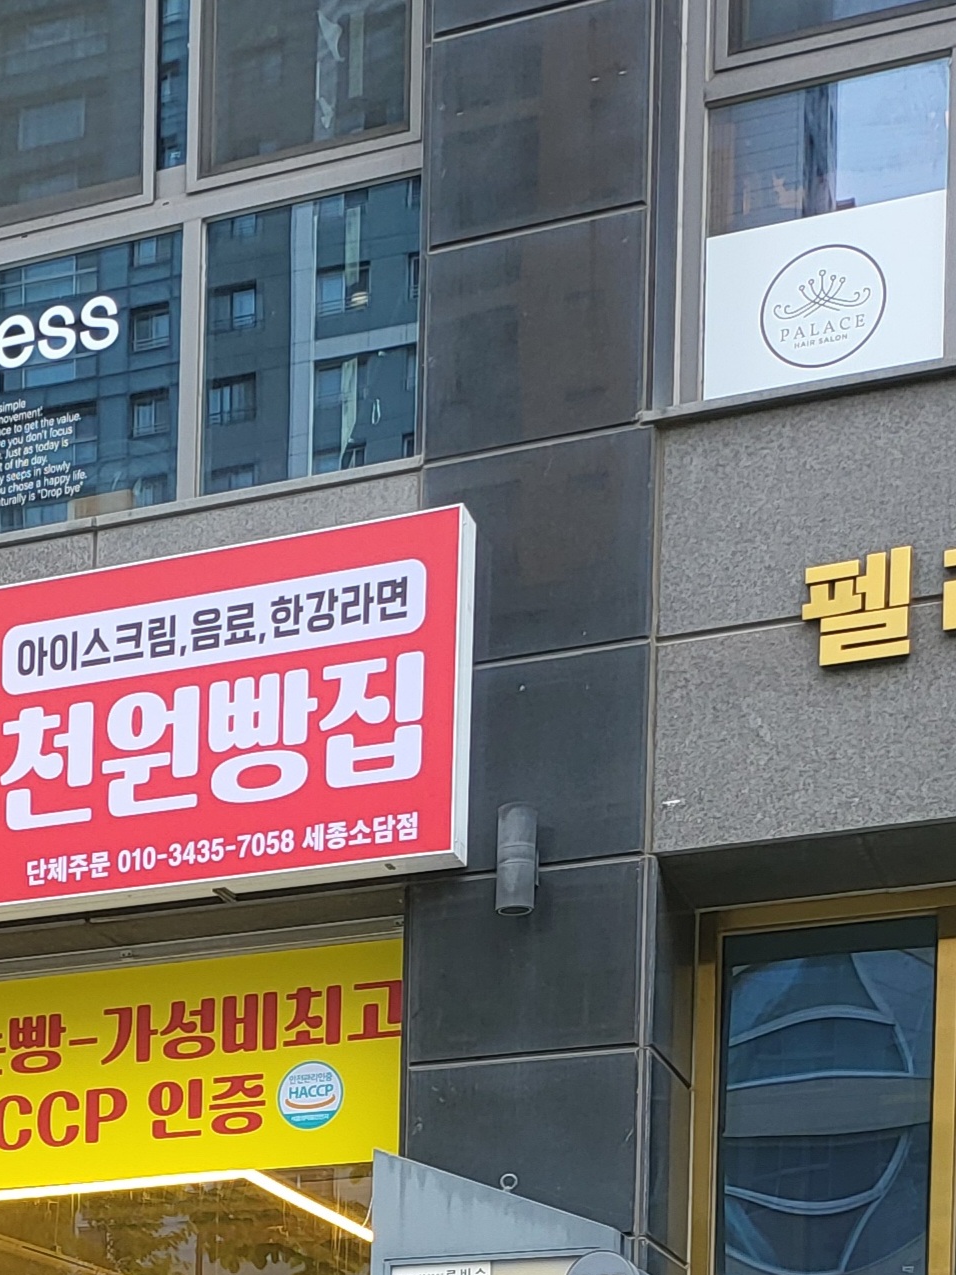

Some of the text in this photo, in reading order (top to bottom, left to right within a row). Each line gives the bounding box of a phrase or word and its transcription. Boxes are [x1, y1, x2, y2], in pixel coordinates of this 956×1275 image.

[780, 313, 866, 342] PALACE
[794, 333, 848, 349] HAIR SALON
[24, 422, 38, 433] get
[41, 418, 54, 427] the
[8, 437, 23, 449] you
[50, 426, 73, 437] focus
[5, 448, 21, 459] Just
[36, 440, 59, 452] today
[6, 469, 31, 482] seeps
[44, 461, 70, 475] slowly
[15, 457, 29, 468] the
[44, 474, 70, 487] happy
[801, 545, 956, 667] 펠
[17, 576, 408, 677] 아이스크림,음료,한강라면
[0, 651, 425, 831] 천원빵집
[26, 811, 419, 886] 단체주문 010-3435-7058 세종소담점
[289, 1084, 334, 1099] HACCP
[148, 1074, 267, 1139] 인증
